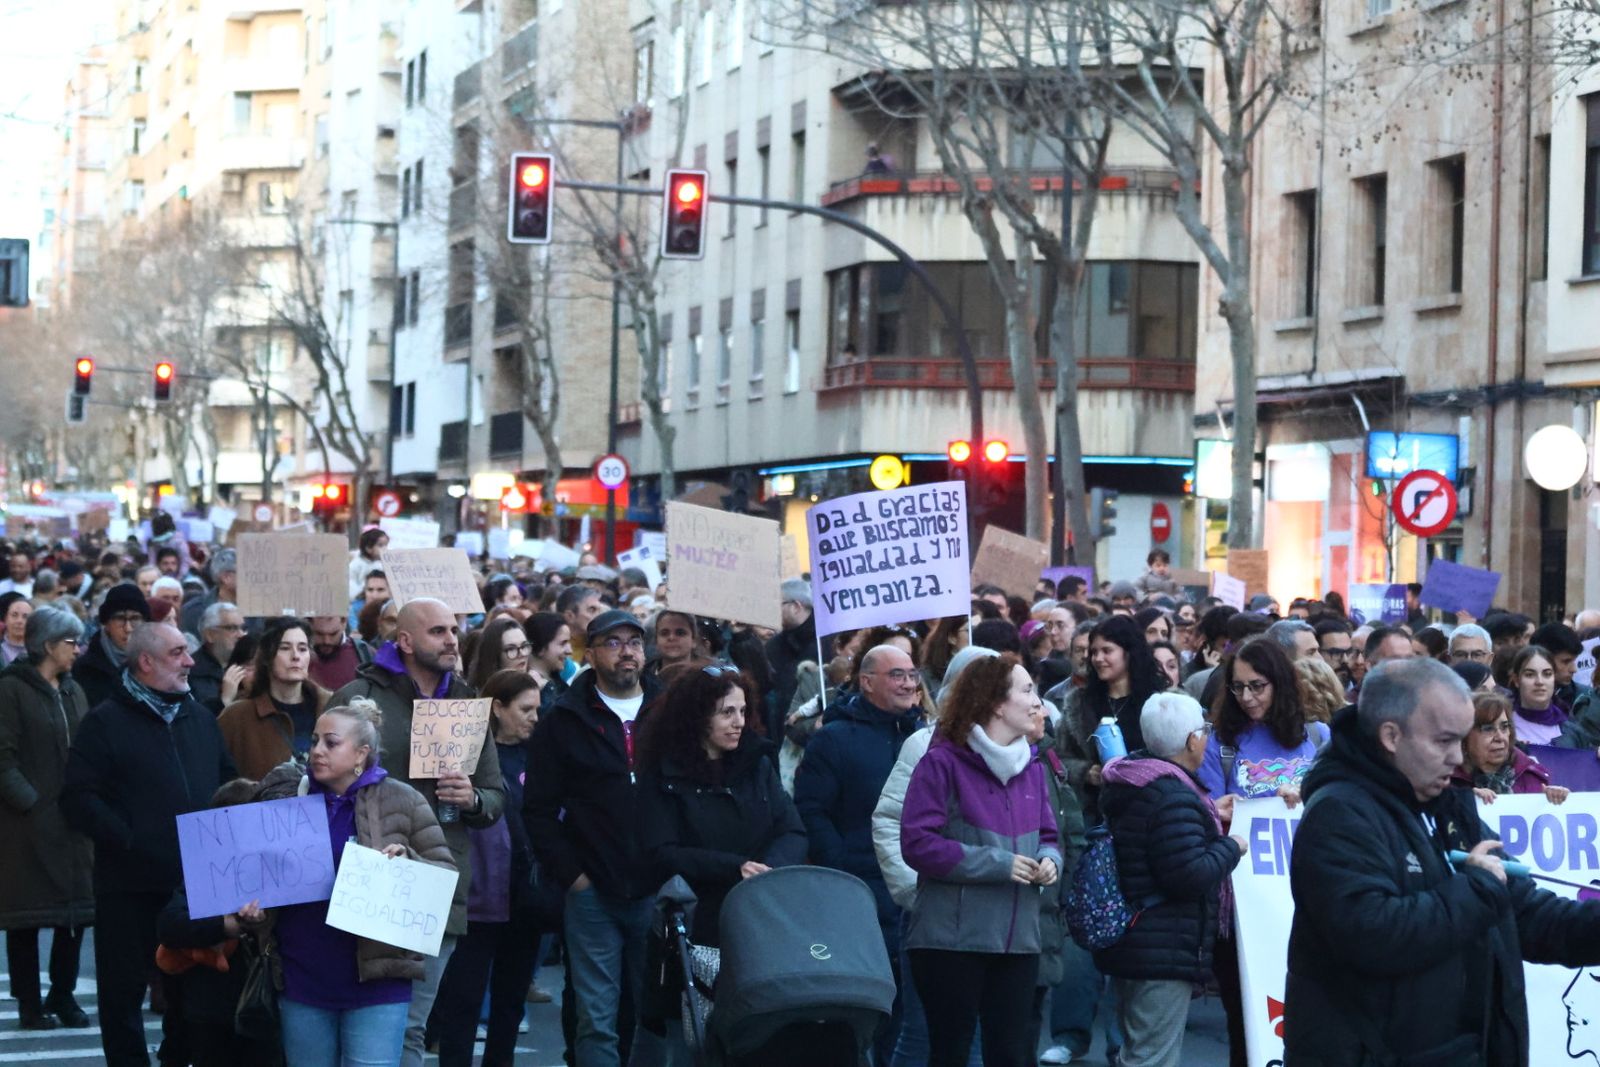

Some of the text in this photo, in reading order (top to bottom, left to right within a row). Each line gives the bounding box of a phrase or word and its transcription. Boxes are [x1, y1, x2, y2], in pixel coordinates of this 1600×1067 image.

[602, 466, 621, 478] 30
[816, 489, 960, 535] Dad Gracias
[675, 543, 738, 571] MUJER
[412, 722, 437, 736] EN
[412, 741, 463, 758] FUTURO
[260, 801, 319, 843] UNA
[1499, 813, 1600, 872] POR
[209, 845, 327, 899] MENOS
[391, 884, 412, 902] LA
[334, 889, 439, 937] IGUALDAD
